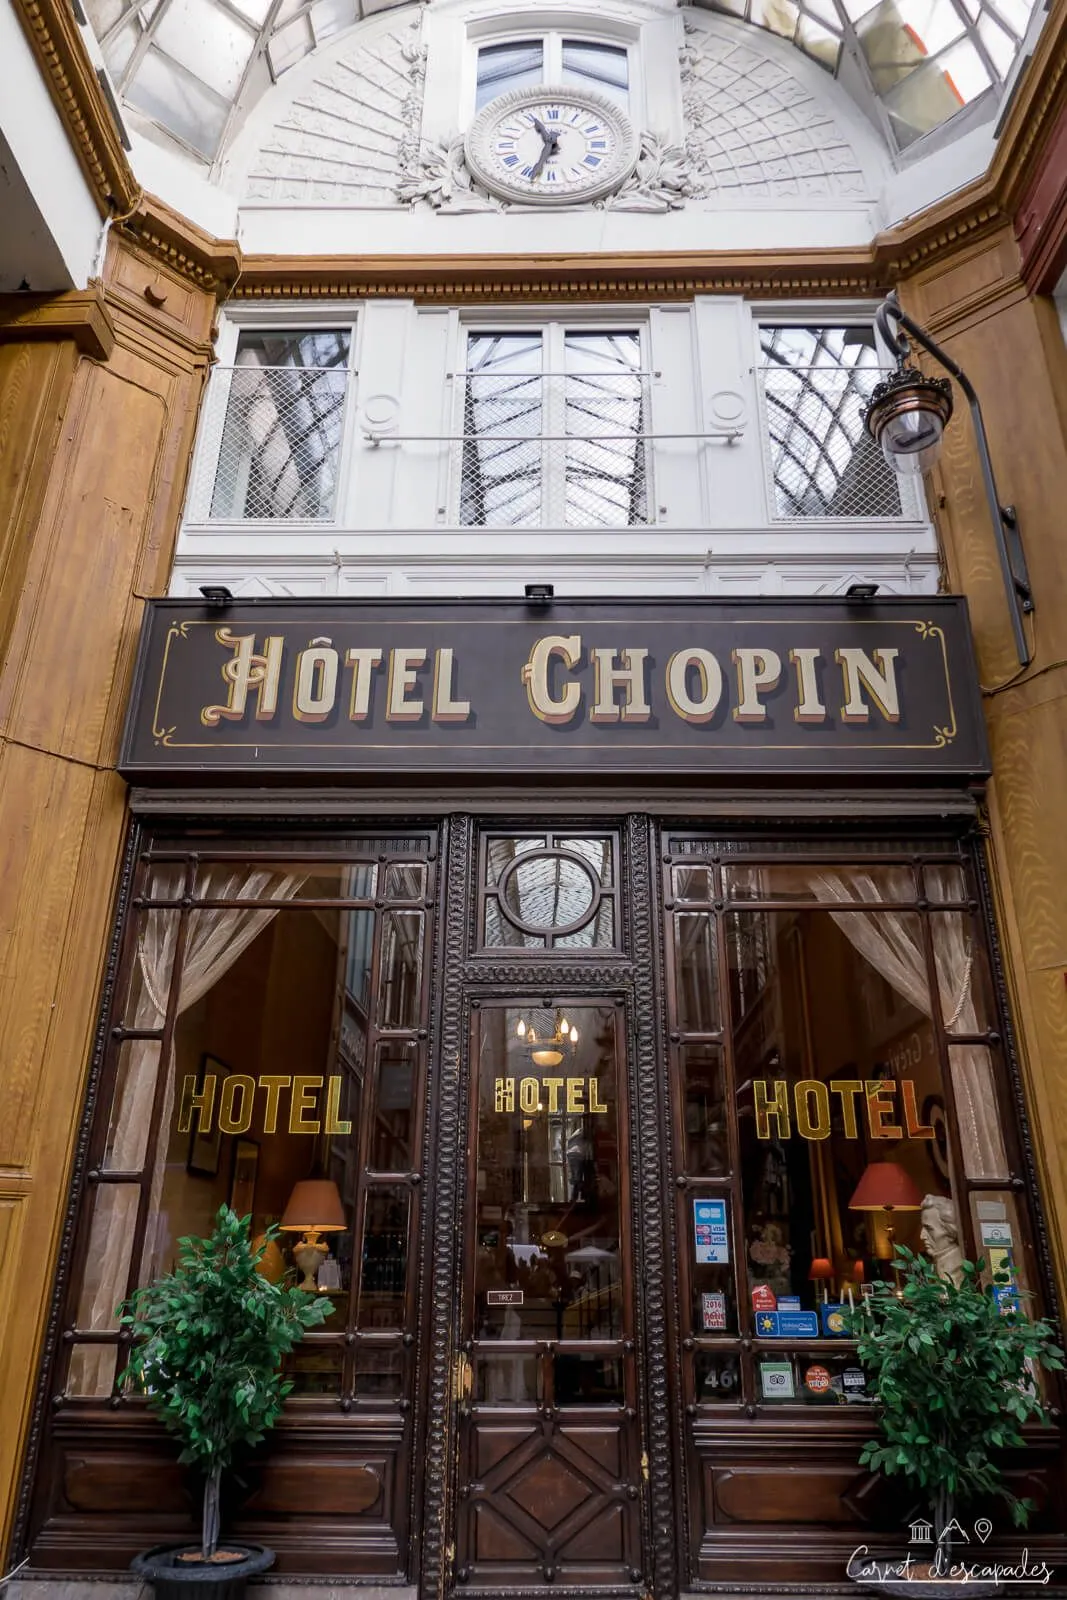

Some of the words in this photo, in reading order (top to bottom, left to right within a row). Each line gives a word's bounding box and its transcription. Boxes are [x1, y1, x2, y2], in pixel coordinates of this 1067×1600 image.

[202, 627, 471, 726] HÔTEL
[522, 634, 902, 725] CHOPIN
[177, 1074, 352, 1135] HOTEL
[494, 1077, 608, 1113] HOTEL
[753, 1079, 936, 1140] HOTEL
[705, 1301, 722, 1309] 2016
[704, 1369, 733, 1388] 46
